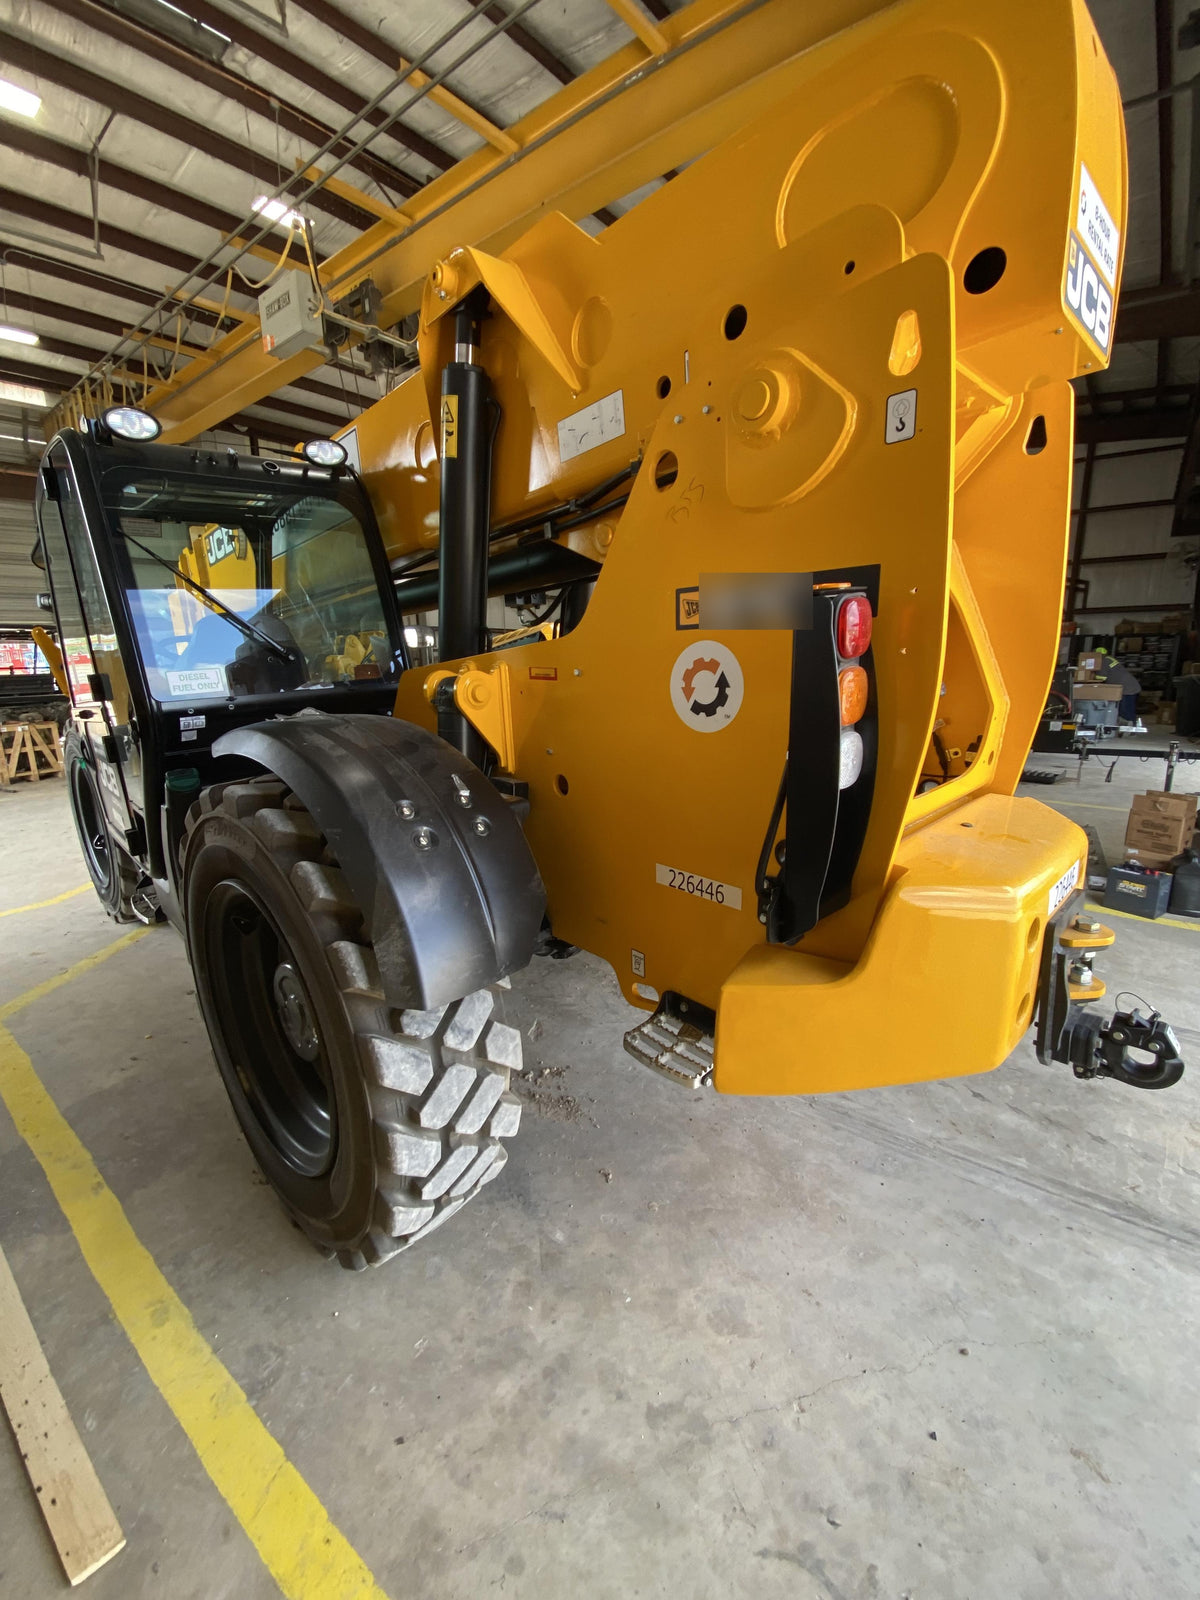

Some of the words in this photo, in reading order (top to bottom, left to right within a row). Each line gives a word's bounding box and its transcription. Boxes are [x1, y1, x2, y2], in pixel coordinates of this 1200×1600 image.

[1088, 219, 1103, 257] RENTAL
[1104, 248, 1114, 274] RATE
[1067, 250, 1111, 348] JCB
[173, 684, 196, 692] FUEL
[198, 682, 220, 690] ONLY
[178, 673, 211, 681] DIESEL
[668, 869, 724, 904] 226446
